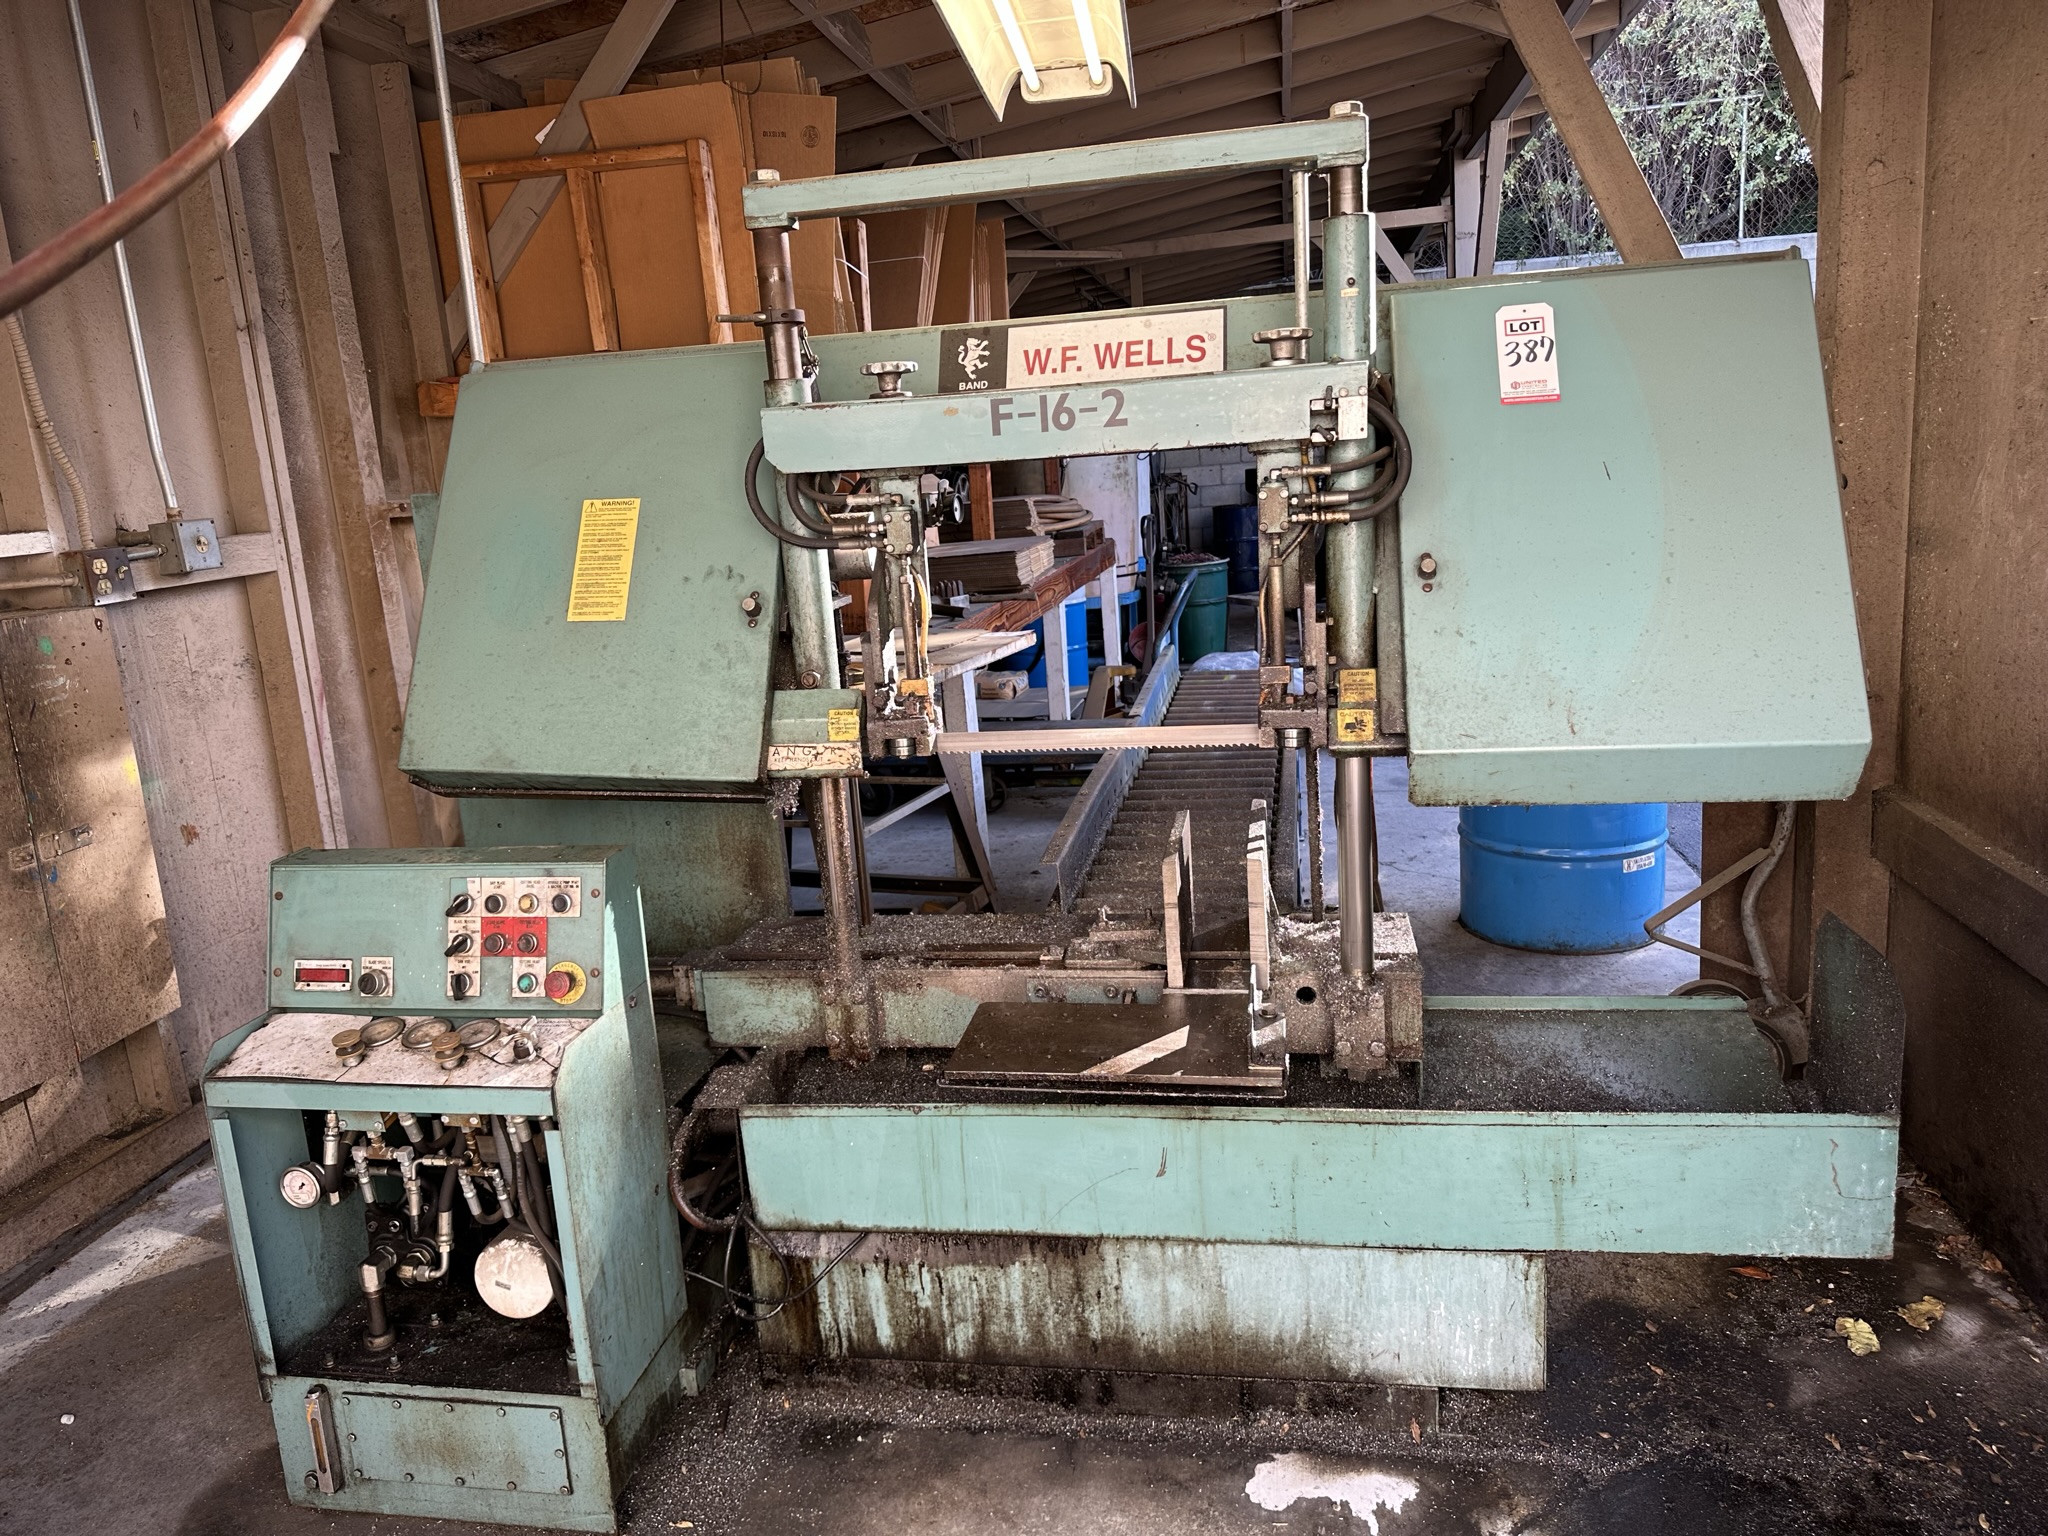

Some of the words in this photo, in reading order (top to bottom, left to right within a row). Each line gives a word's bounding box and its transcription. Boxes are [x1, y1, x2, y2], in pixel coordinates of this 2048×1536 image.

[1510, 320, 1540, 332] LOT
[1023, 345, 1083, 376] W.F.
[1094, 334, 1207, 370] WELLS
[1504, 335, 1554, 367] 387
[958, 380, 989, 391] BAND
[989, 388, 1129, 437] F-16-2
[772, 746, 837, 757] ANGR
